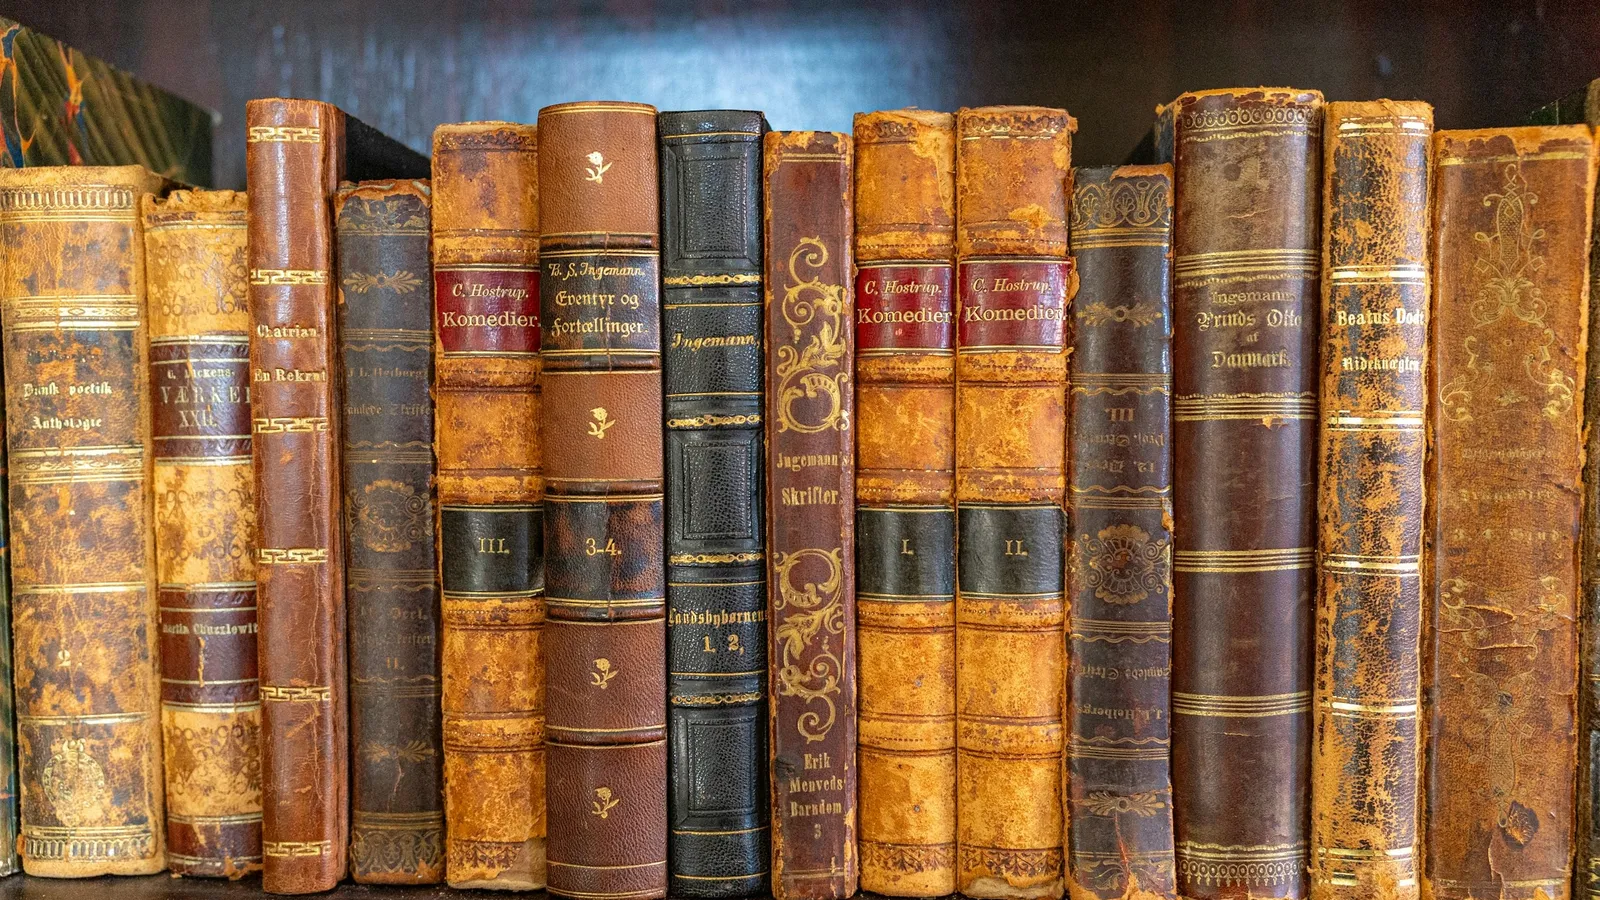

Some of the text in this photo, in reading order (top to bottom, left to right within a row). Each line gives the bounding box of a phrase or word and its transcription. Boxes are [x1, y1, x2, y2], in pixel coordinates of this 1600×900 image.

[580, 262, 647, 280] Ingemann.
[452, 284, 529, 301] C. Hostrup.
[865, 281, 942, 298] C. Hostrup.
[972, 279, 1053, 296] C. Hostrup.
[555, 290, 640, 310] Eventyr og
[442, 312, 541, 328] Komedier.
[965, 306, 1067, 323] Komedier.
[1337, 310, 1391, 326] Beatus
[254, 369, 271, 382] En
[478, 537, 510, 555] III.
[1005, 539, 1028, 556] II.
[803, 752, 831, 770] Erik
[791, 798, 842, 817] Barndom
